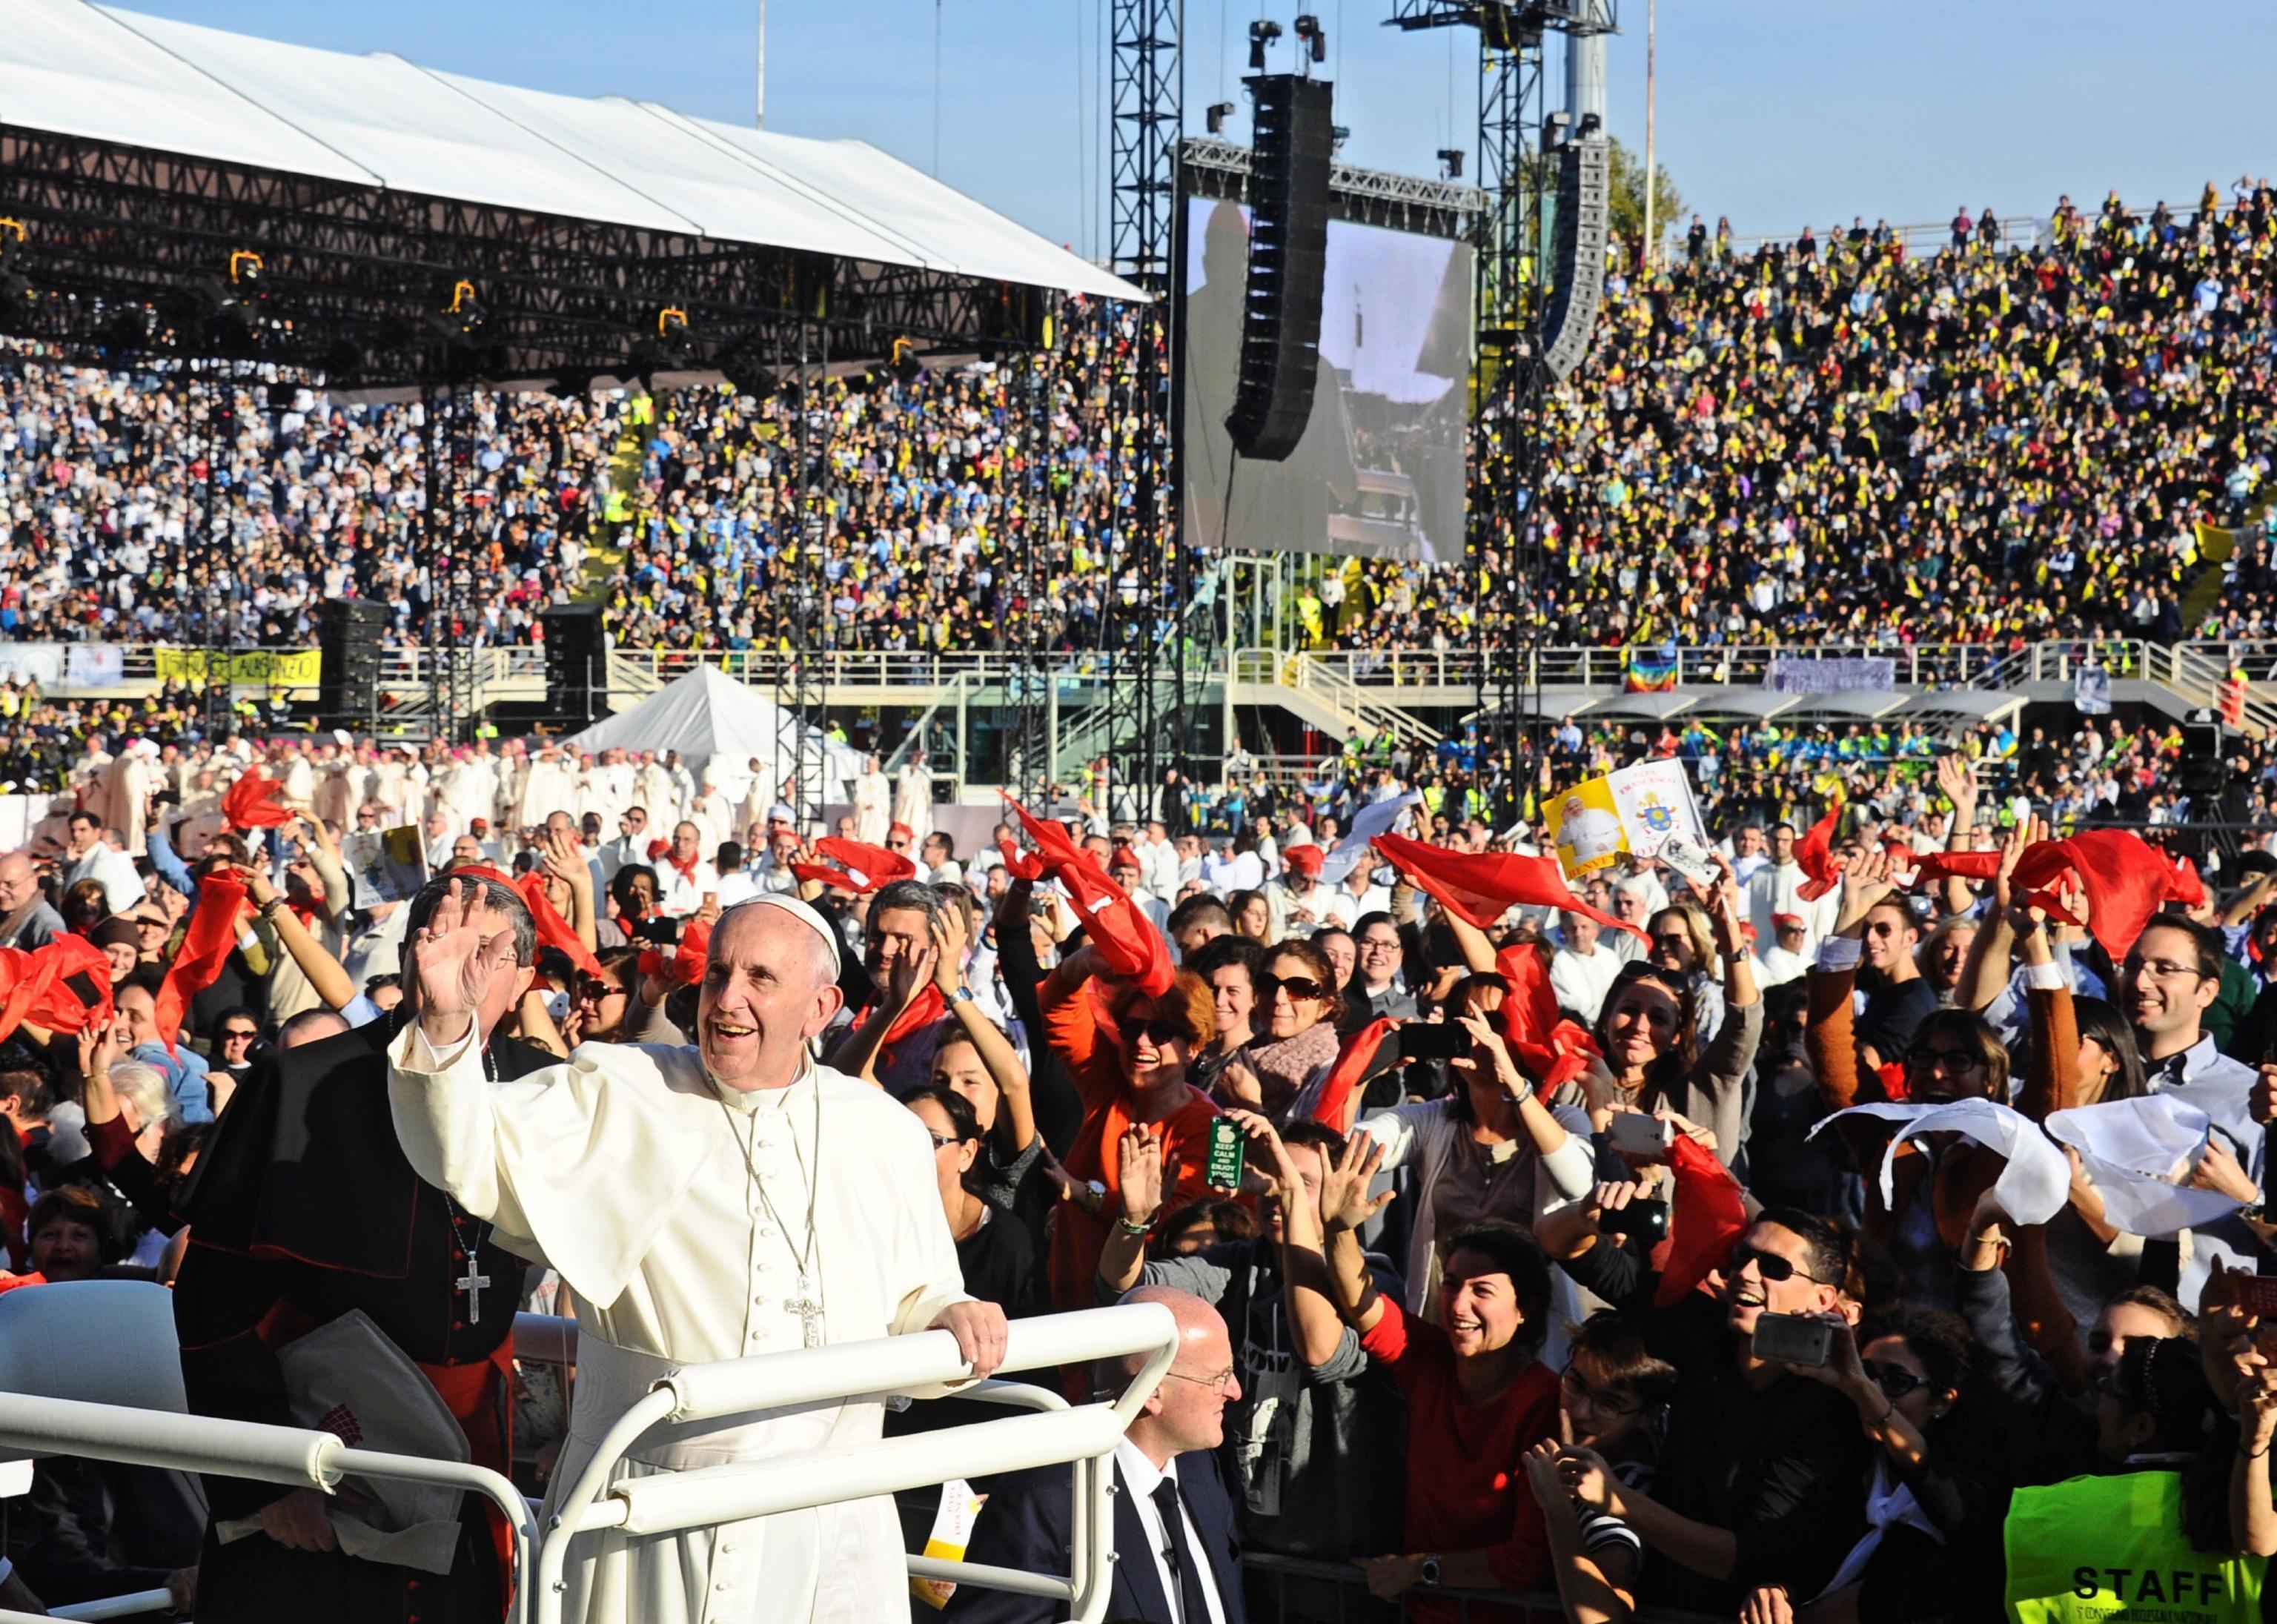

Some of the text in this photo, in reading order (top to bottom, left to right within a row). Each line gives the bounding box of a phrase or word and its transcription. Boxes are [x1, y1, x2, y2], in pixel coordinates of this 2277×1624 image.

[1215, 1142, 1236, 1150] KEEP
[1213, 1150, 1236, 1159] CALM
[1210, 1163, 1236, 1172] ENJOY
[2073, 1566, 2223, 1606] STAFF
